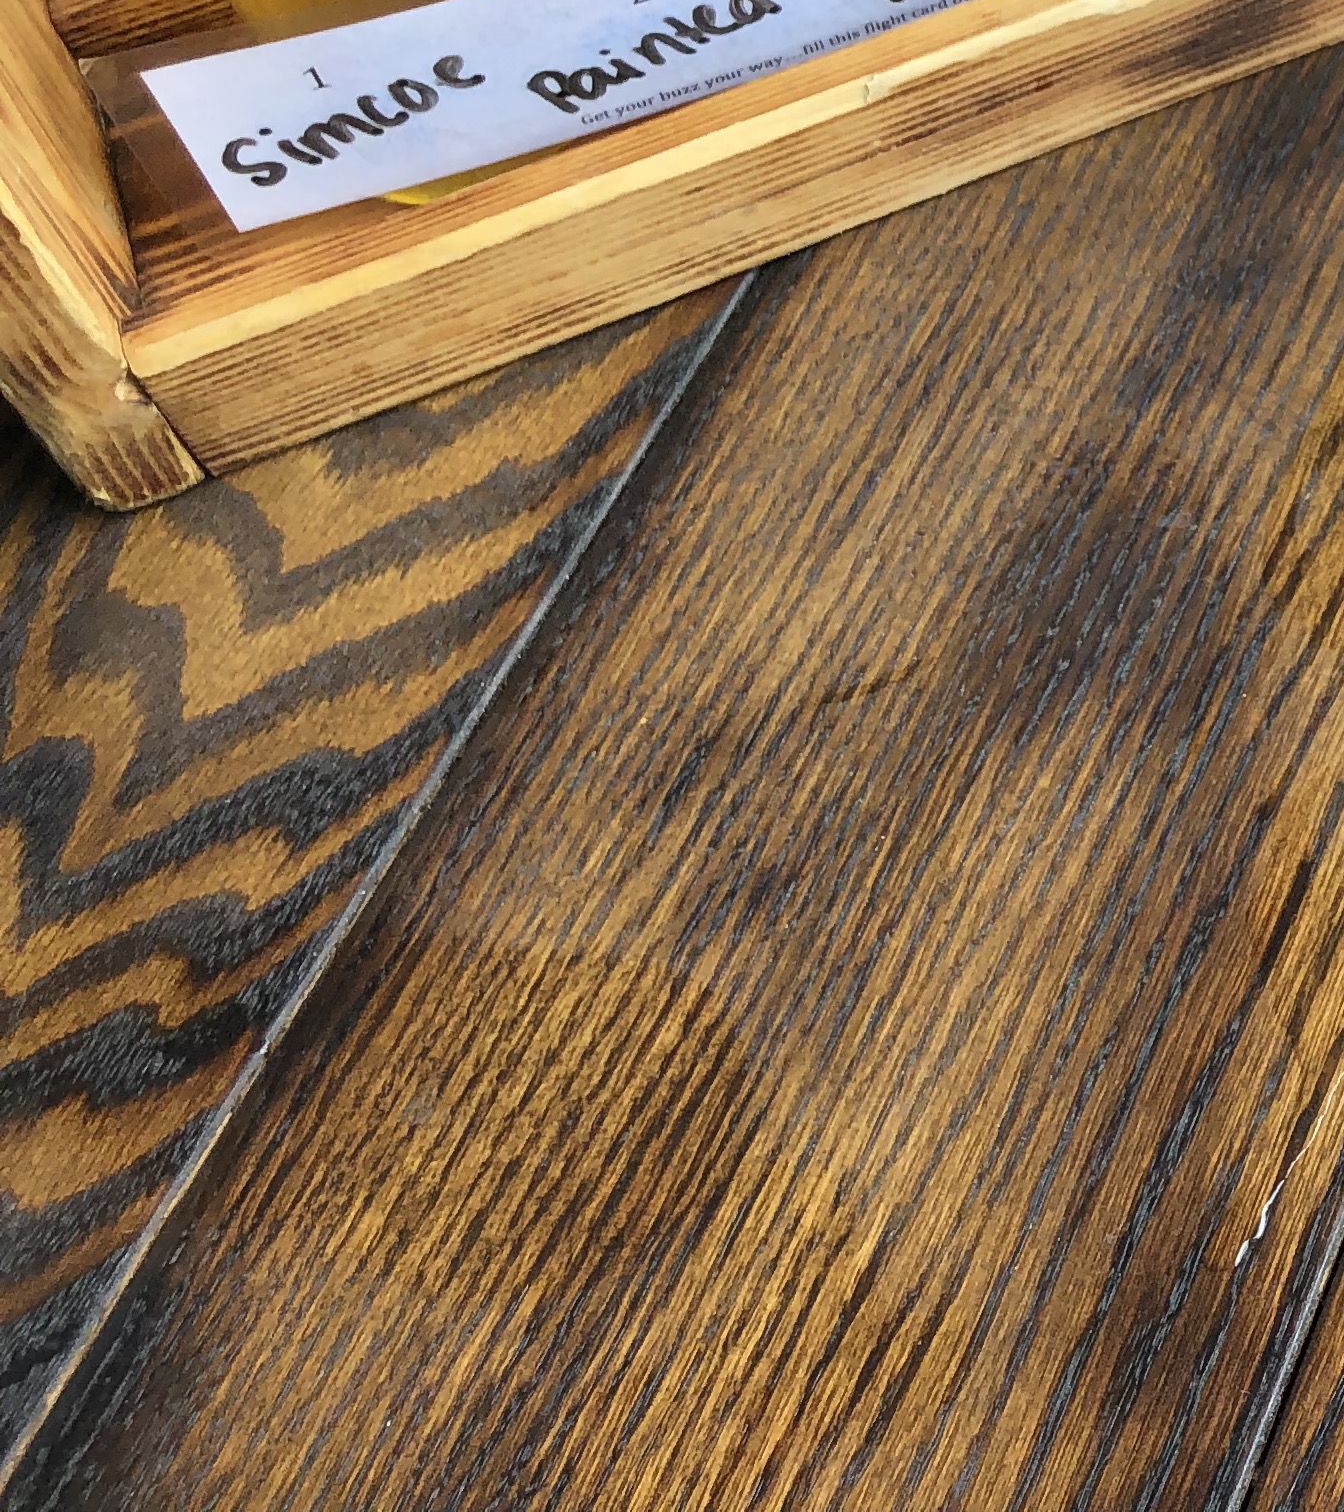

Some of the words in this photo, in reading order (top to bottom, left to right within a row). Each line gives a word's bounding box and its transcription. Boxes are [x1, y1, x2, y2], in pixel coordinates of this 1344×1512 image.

[303, 66, 331, 90] 1
[615, 95, 655, 118] your
[659, 81, 700, 102] buzz
[704, 67, 744, 89] your
[828, 29, 861, 47] this
[864, 10, 907, 36] flight
[222, 54, 486, 187] Simcoe
